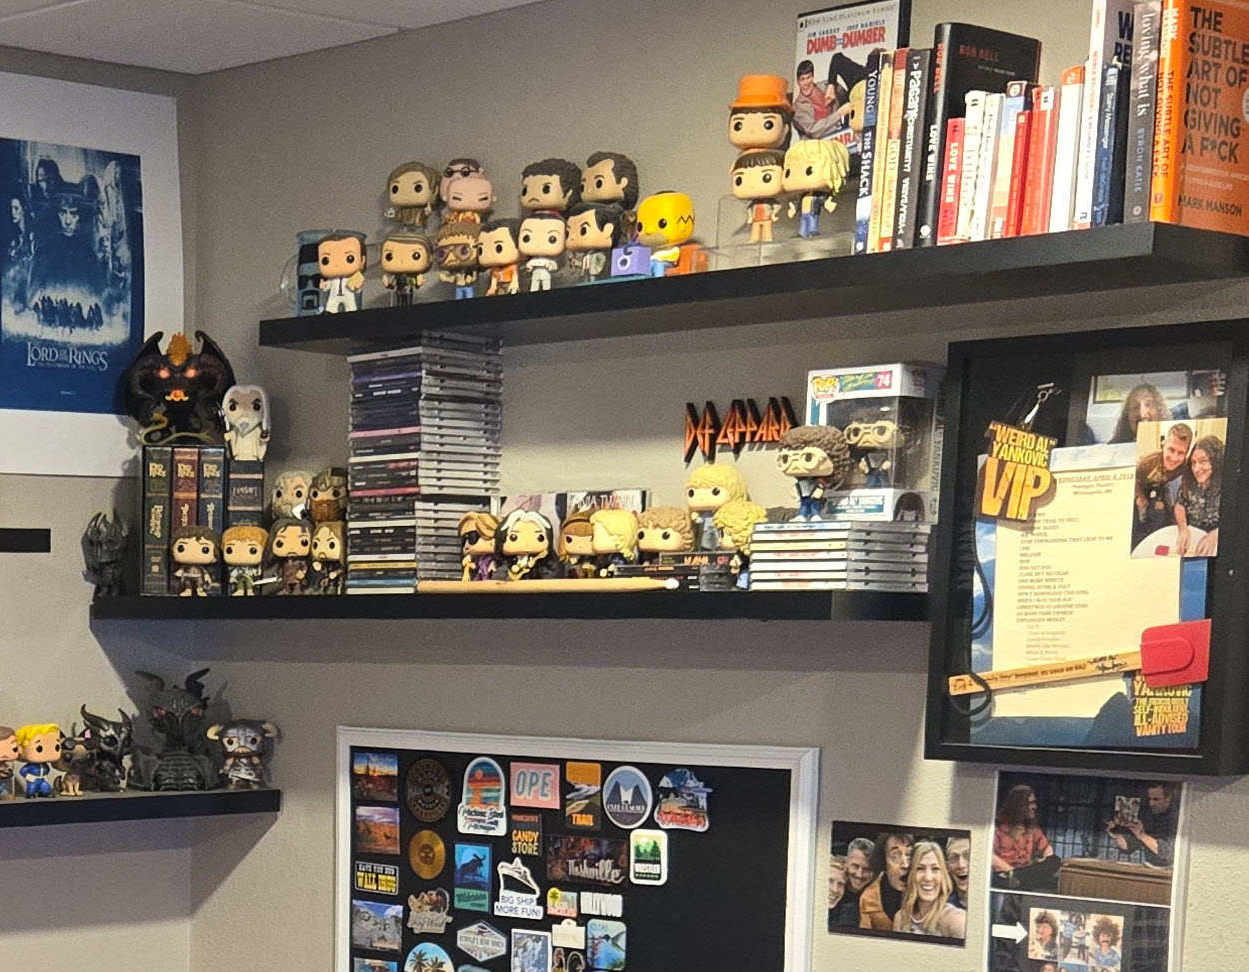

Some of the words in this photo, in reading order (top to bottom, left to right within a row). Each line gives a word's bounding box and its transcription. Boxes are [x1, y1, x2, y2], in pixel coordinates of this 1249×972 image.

[1189, 6, 1224, 33] THE
[806, 34, 837, 55] DUMB
[841, 26, 886, 49] DUMBER
[1137, 12, 1157, 61] loving
[1188, 31, 1249, 66] SUBTLE
[1137, 62, 1154, 100] what
[1157, 72, 1165, 94] NOT
[1167, 69, 1175, 93] THE
[1186, 60, 1222, 84] ART
[1226, 66, 1248, 89] OF
[865, 70, 879, 113] YOUNG
[1185, 81, 1221, 109] NOT
[1137, 103, 1151, 117] is
[1163, 96, 1173, 135] SUBTLE
[1183, 107, 1241, 139] GIVING
[948, 142, 959, 172] LOVE
[1135, 127, 1146, 162] BYRON
[1162, 139, 1171, 161] ART
[1181, 133, 1195, 156] A
[858, 151, 872, 198] SHACK
[1160, 163, 1169, 179] OF
[945, 174, 957, 204] WINS
[1178, 194, 1204, 210] MARK
[1206, 198, 1243, 217] MANSON
[26, 341, 59, 367] LORD
[69, 347, 109, 372] RINGS
[877, 374, 891, 388] 74
[684, 402, 715, 458] DEF
[716, 398, 793, 451] LEPPARD
[992, 441, 1049, 467] YANKOVIC
[981, 457, 1051, 520] VIP
[515, 769, 553, 798] OPE
[571, 813, 594, 827] TRAIL
[511, 829, 539, 843] CANDY
[511, 841, 539, 856] STORE
[566, 858, 626, 885] Nashville
[495, 905, 517, 915] MORE
[520, 907, 541, 917] FUN!
[500, 895, 515, 904] BIG
[516, 896, 535, 905] SHIP
